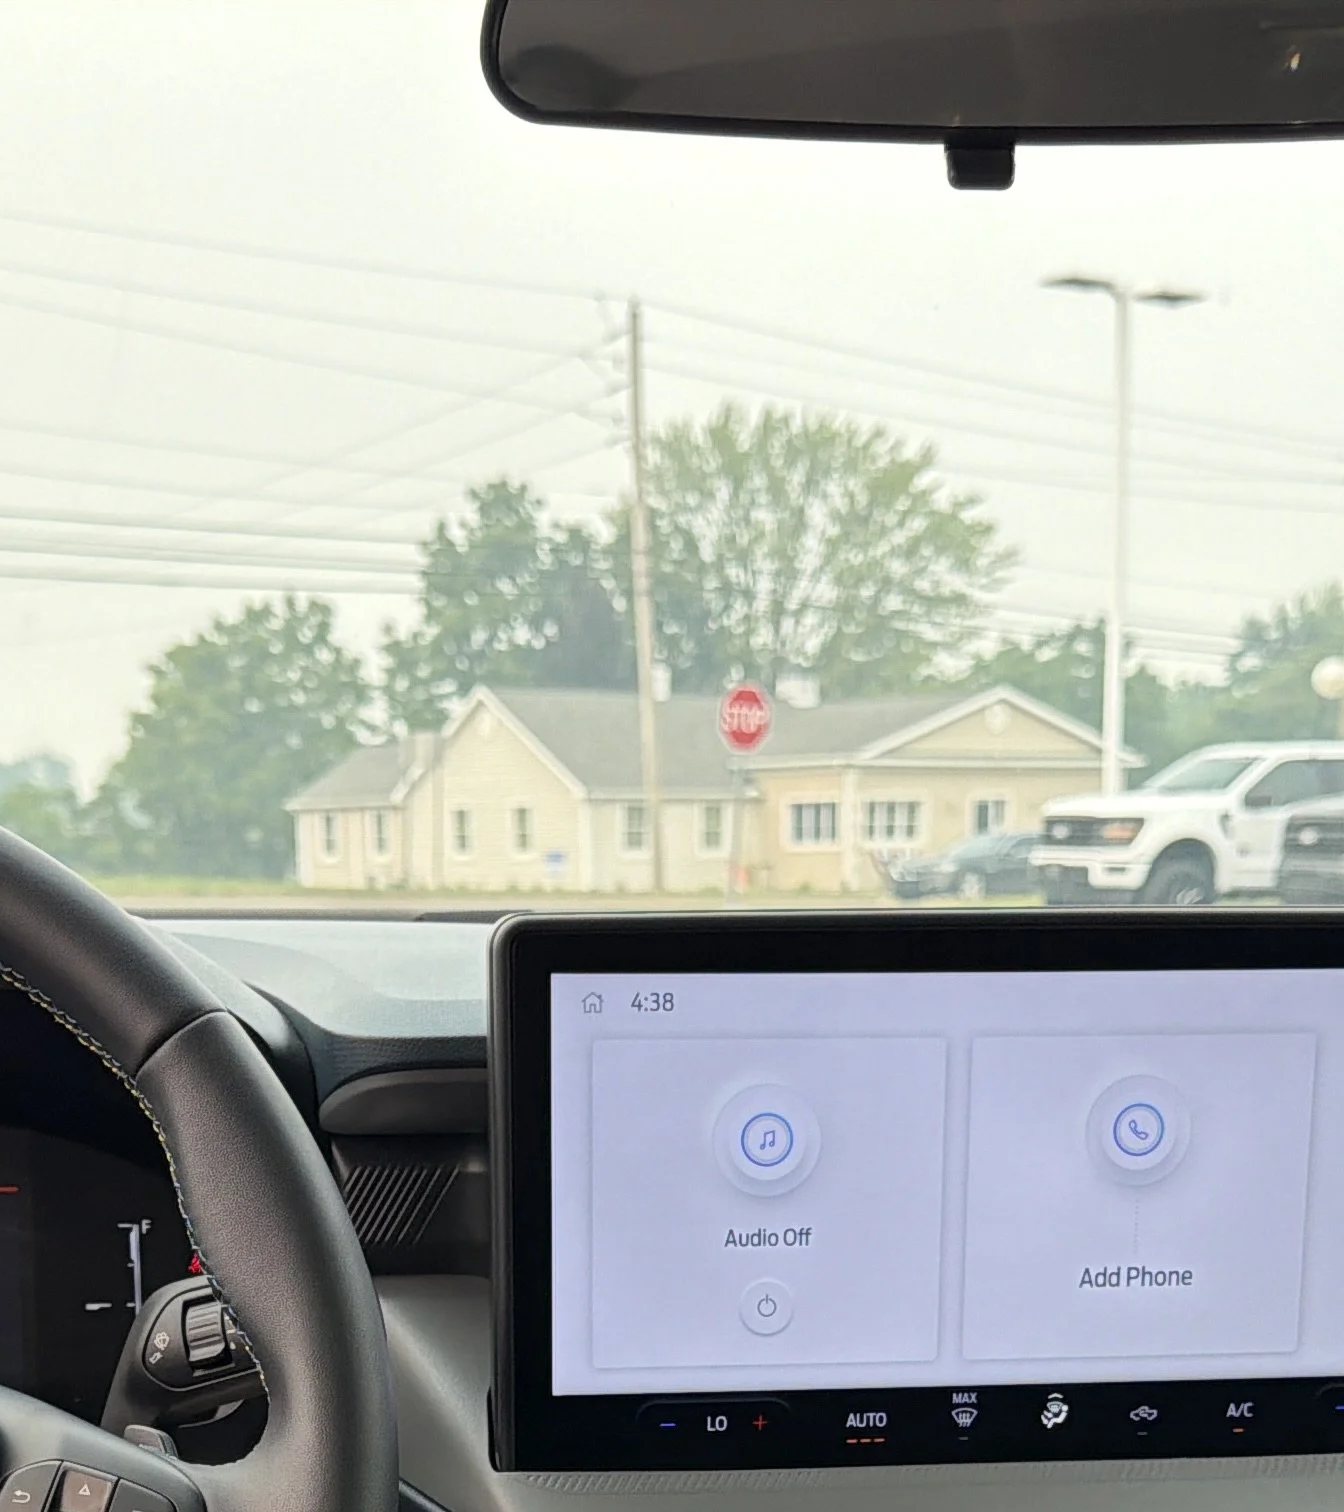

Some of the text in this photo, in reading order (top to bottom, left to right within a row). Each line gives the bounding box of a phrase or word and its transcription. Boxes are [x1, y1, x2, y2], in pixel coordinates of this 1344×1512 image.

[721, 702, 768, 733] STOP
[630, 992, 675, 1013] 4:38
[141, 1219, 152, 1234] F
[724, 1227, 813, 1247] Audio Off
[1078, 1265, 1193, 1288] Add Phone
[952, 1392, 978, 1404] MAX
[1226, 1402, 1254, 1418] A/C
[706, 1415, 728, 1432] LO
[846, 1412, 887, 1428] AUTO
